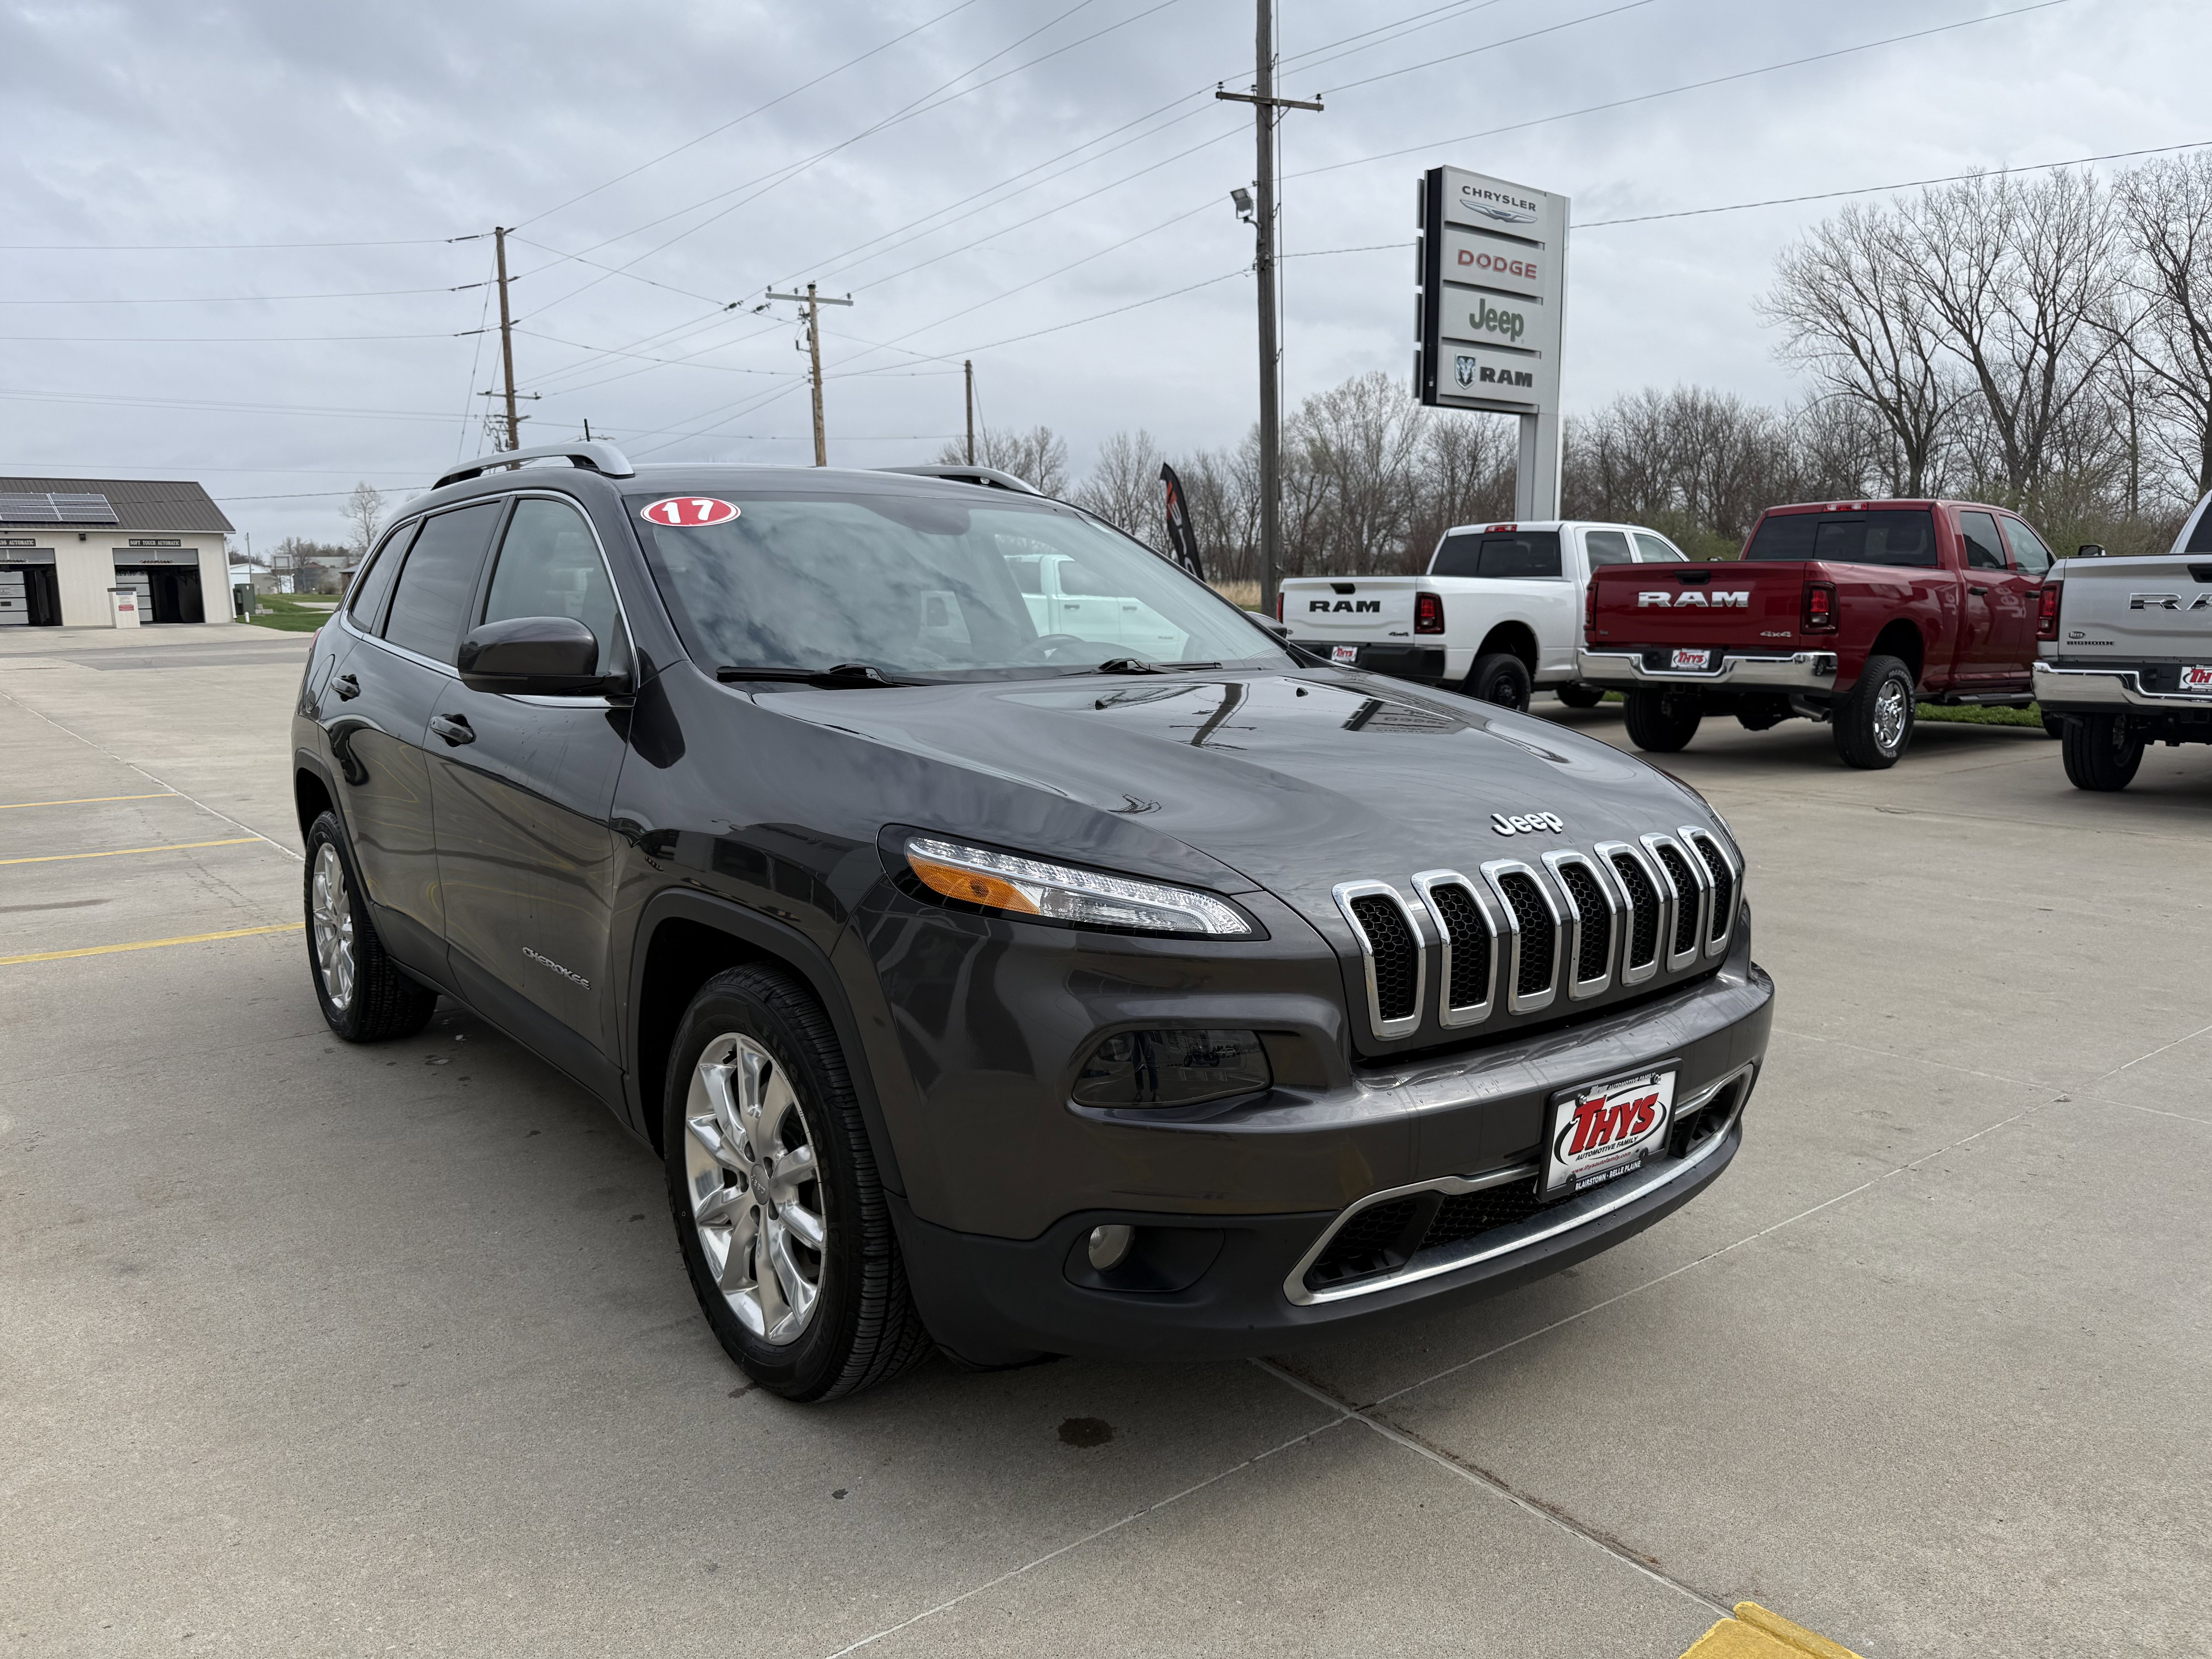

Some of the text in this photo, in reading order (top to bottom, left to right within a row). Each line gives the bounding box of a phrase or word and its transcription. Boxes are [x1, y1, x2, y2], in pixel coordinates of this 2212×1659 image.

[1462, 185, 1536, 212] CHRYSLER
[1458, 249, 1537, 280] DODGE
[1469, 298, 1524, 342] Jeep
[1479, 366, 1532, 388] RAM
[661, 500, 714, 524] 17
[1309, 601, 1380, 613] RAM
[1638, 591, 1750, 608] RAM
[1678, 652, 1704, 663] THYS
[1491, 811, 1563, 836] Jeep
[522, 946, 591, 990] CHEROKEE
[1608, 1078, 1639, 1090] AUTOMOTIVE
[1568, 1092, 1659, 1156] THYS
[1575, 1136, 1638, 1161] AUTOMOTIVE FAMILY
[1575, 1160, 1642, 1191] BLAIRSTOWN BELLE PLAINE
